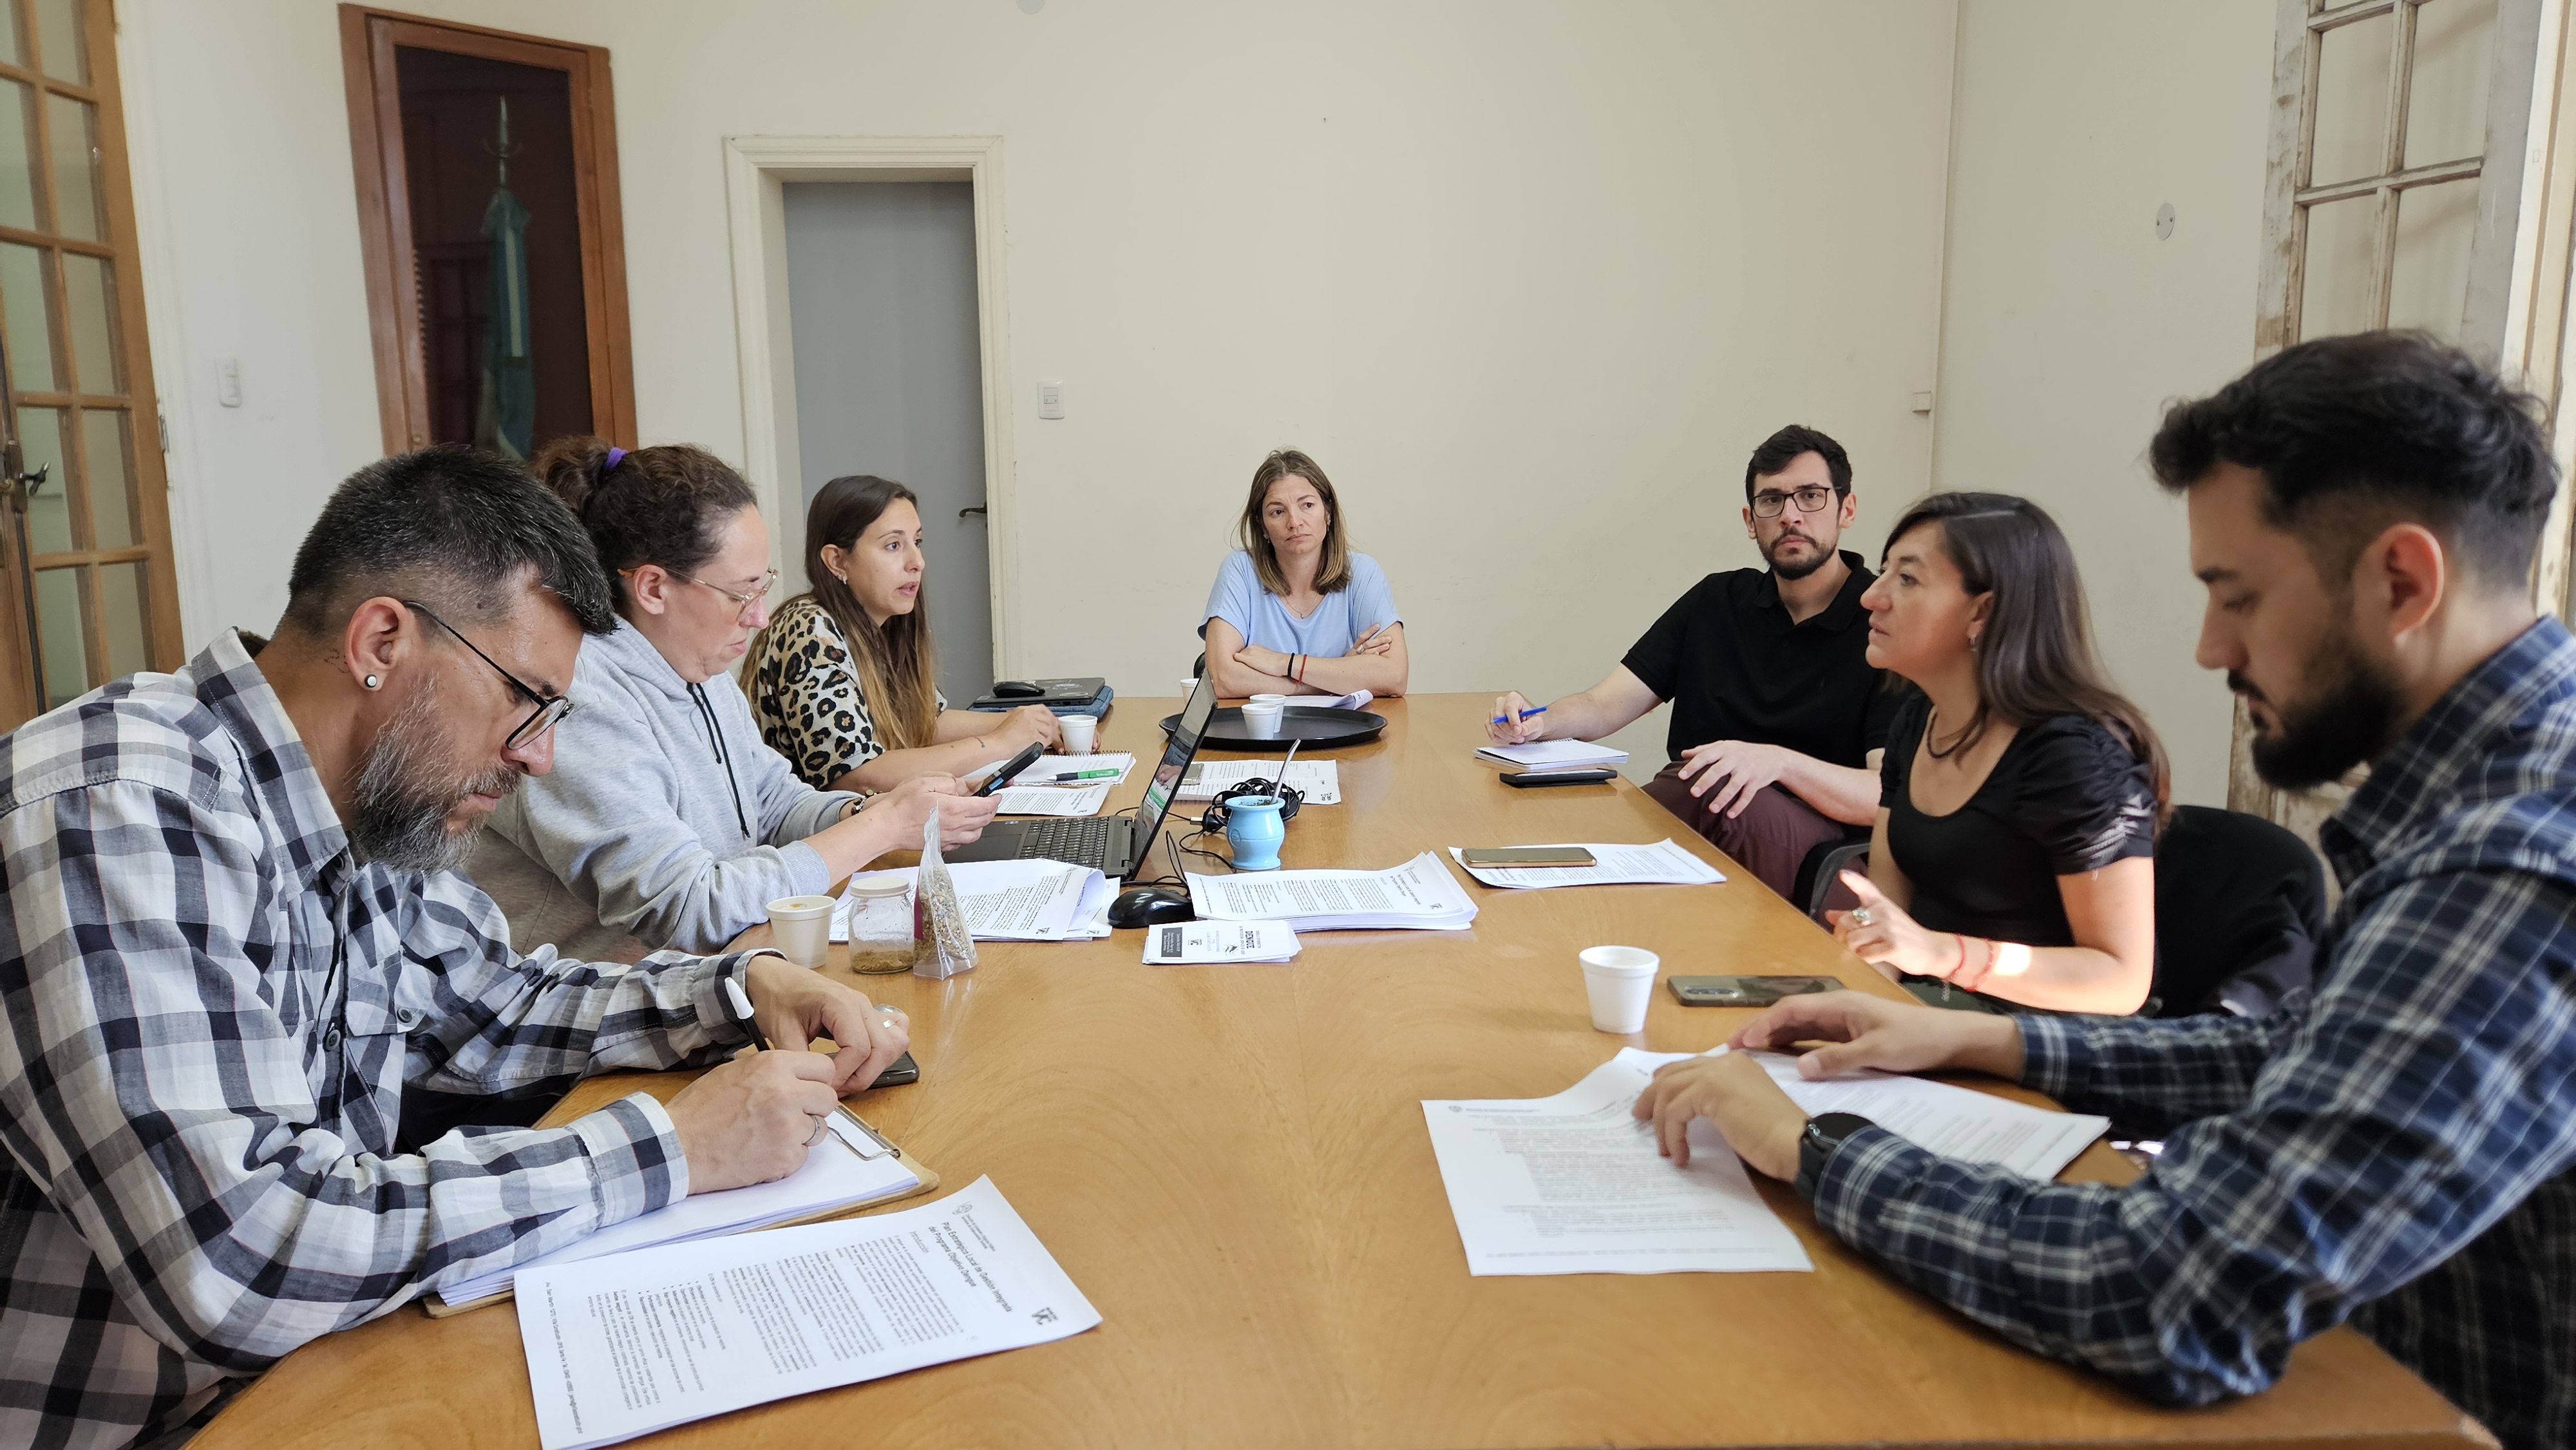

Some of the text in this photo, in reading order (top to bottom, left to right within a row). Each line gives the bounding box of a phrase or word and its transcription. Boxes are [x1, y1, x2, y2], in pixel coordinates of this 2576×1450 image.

[933, 1232, 951, 1252] Programa
[947, 1252, 964, 1270] Objetivo
[960, 1270, 977, 1286] Dengue
[942, 1221, 952, 1231] Plan
[965, 1254, 979, 1266] Local
[979, 1272, 996, 1290] Gestión
